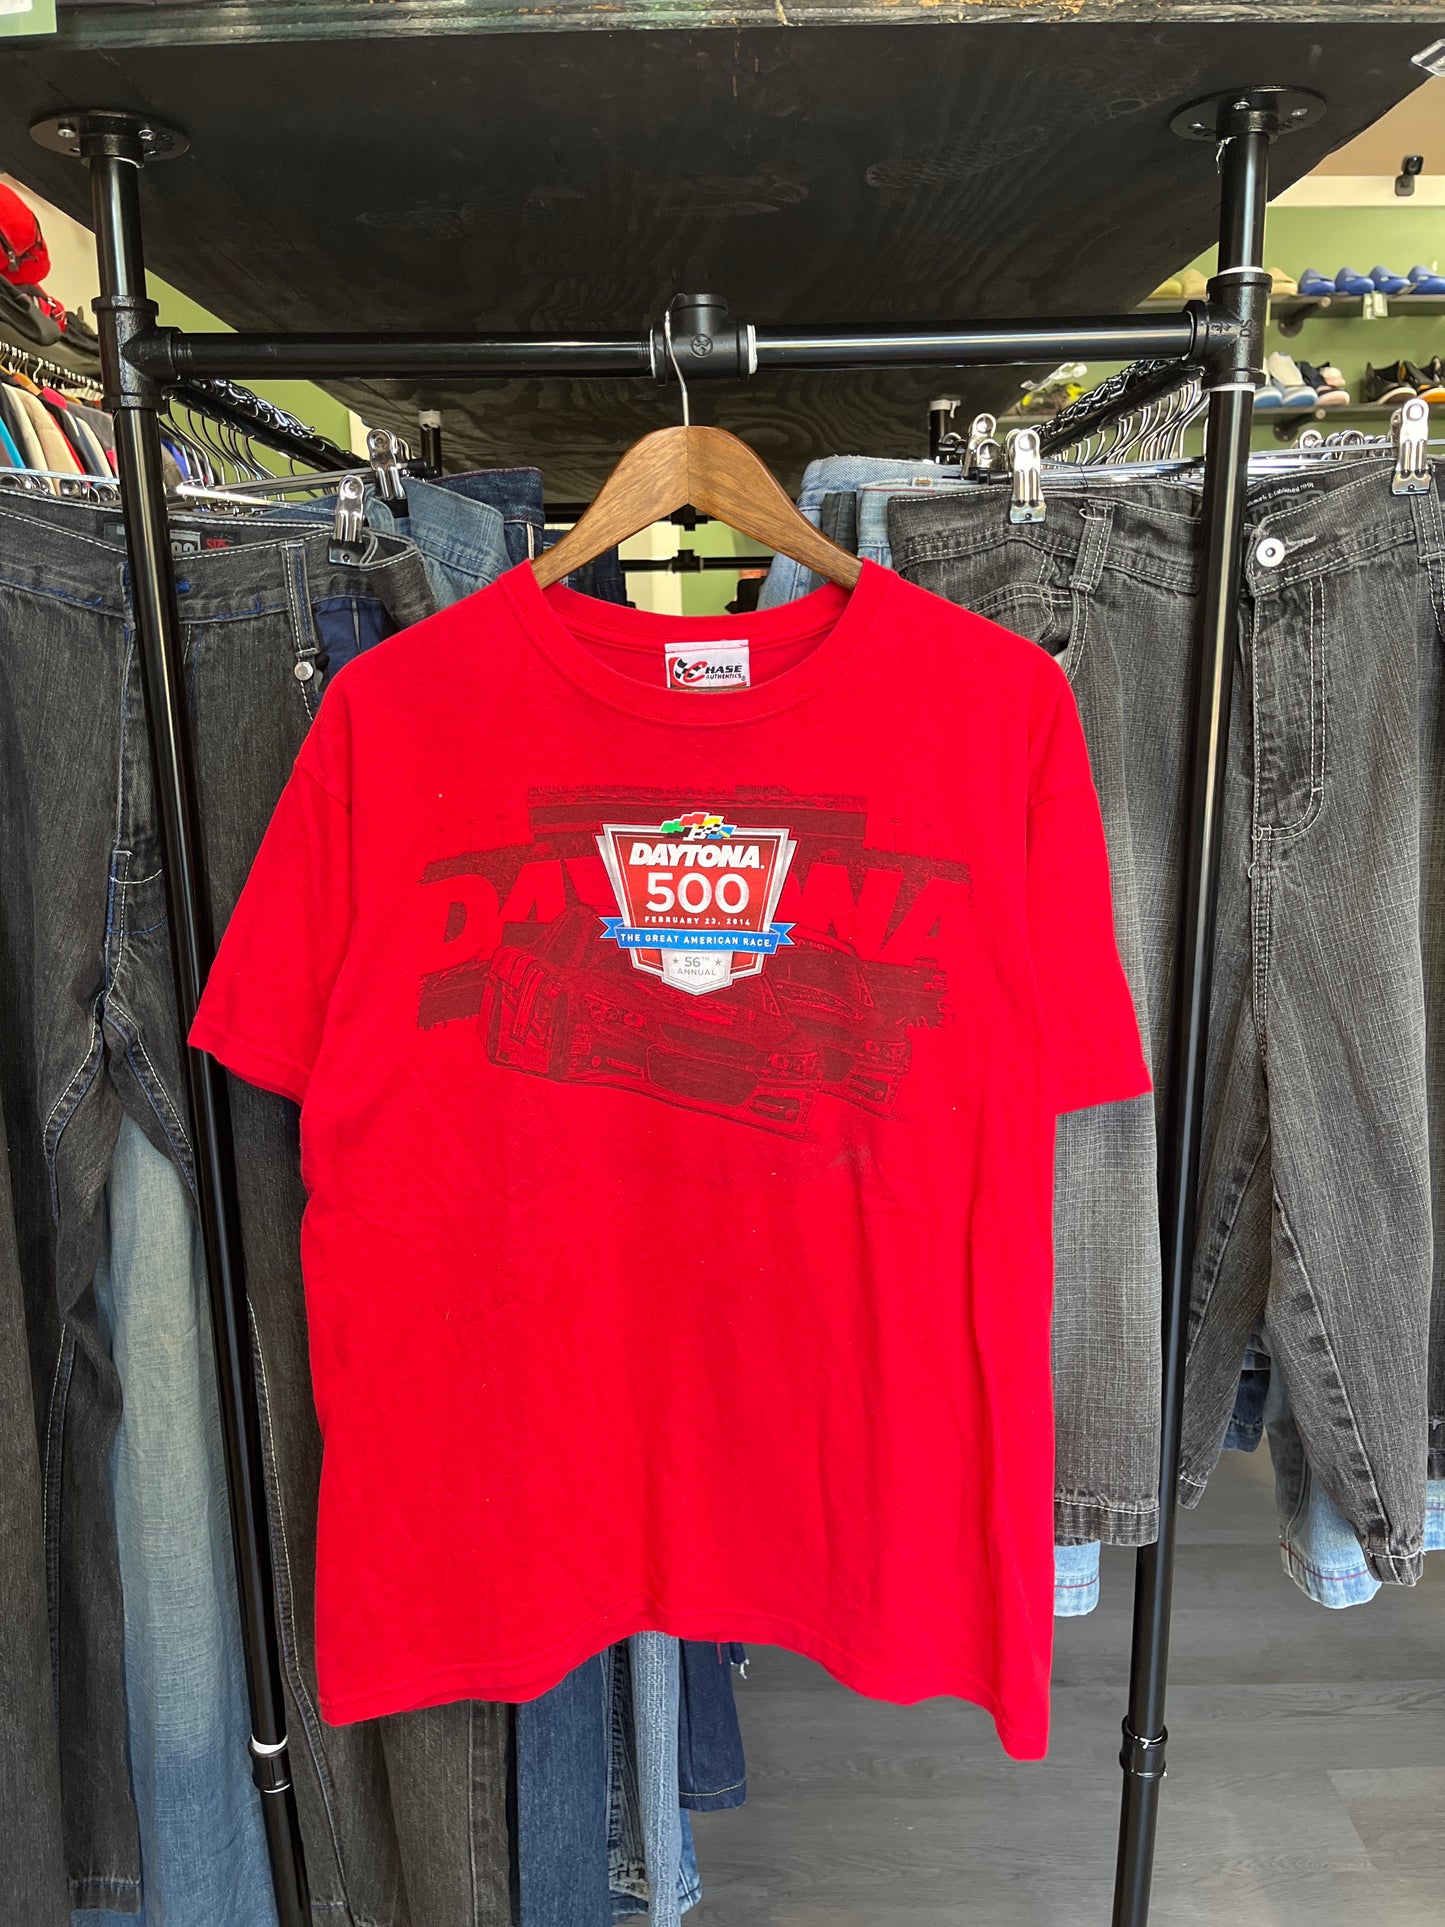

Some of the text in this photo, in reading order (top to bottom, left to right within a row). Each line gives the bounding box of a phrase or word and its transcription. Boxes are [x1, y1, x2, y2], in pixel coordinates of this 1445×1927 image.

[1268, 486, 1300, 499] Etablished
[683, 661, 742, 683] CHASE
[645, 872, 750, 914] 500
[644, 916, 700, 925] FEBRUARY
[726, 918, 751, 926] 2014
[620, 933, 641, 942] THE
[645, 934, 679, 943] GREAT
[683, 936, 739, 945] AMERICAN
[677, 968, 717, 976] ANNUAL
